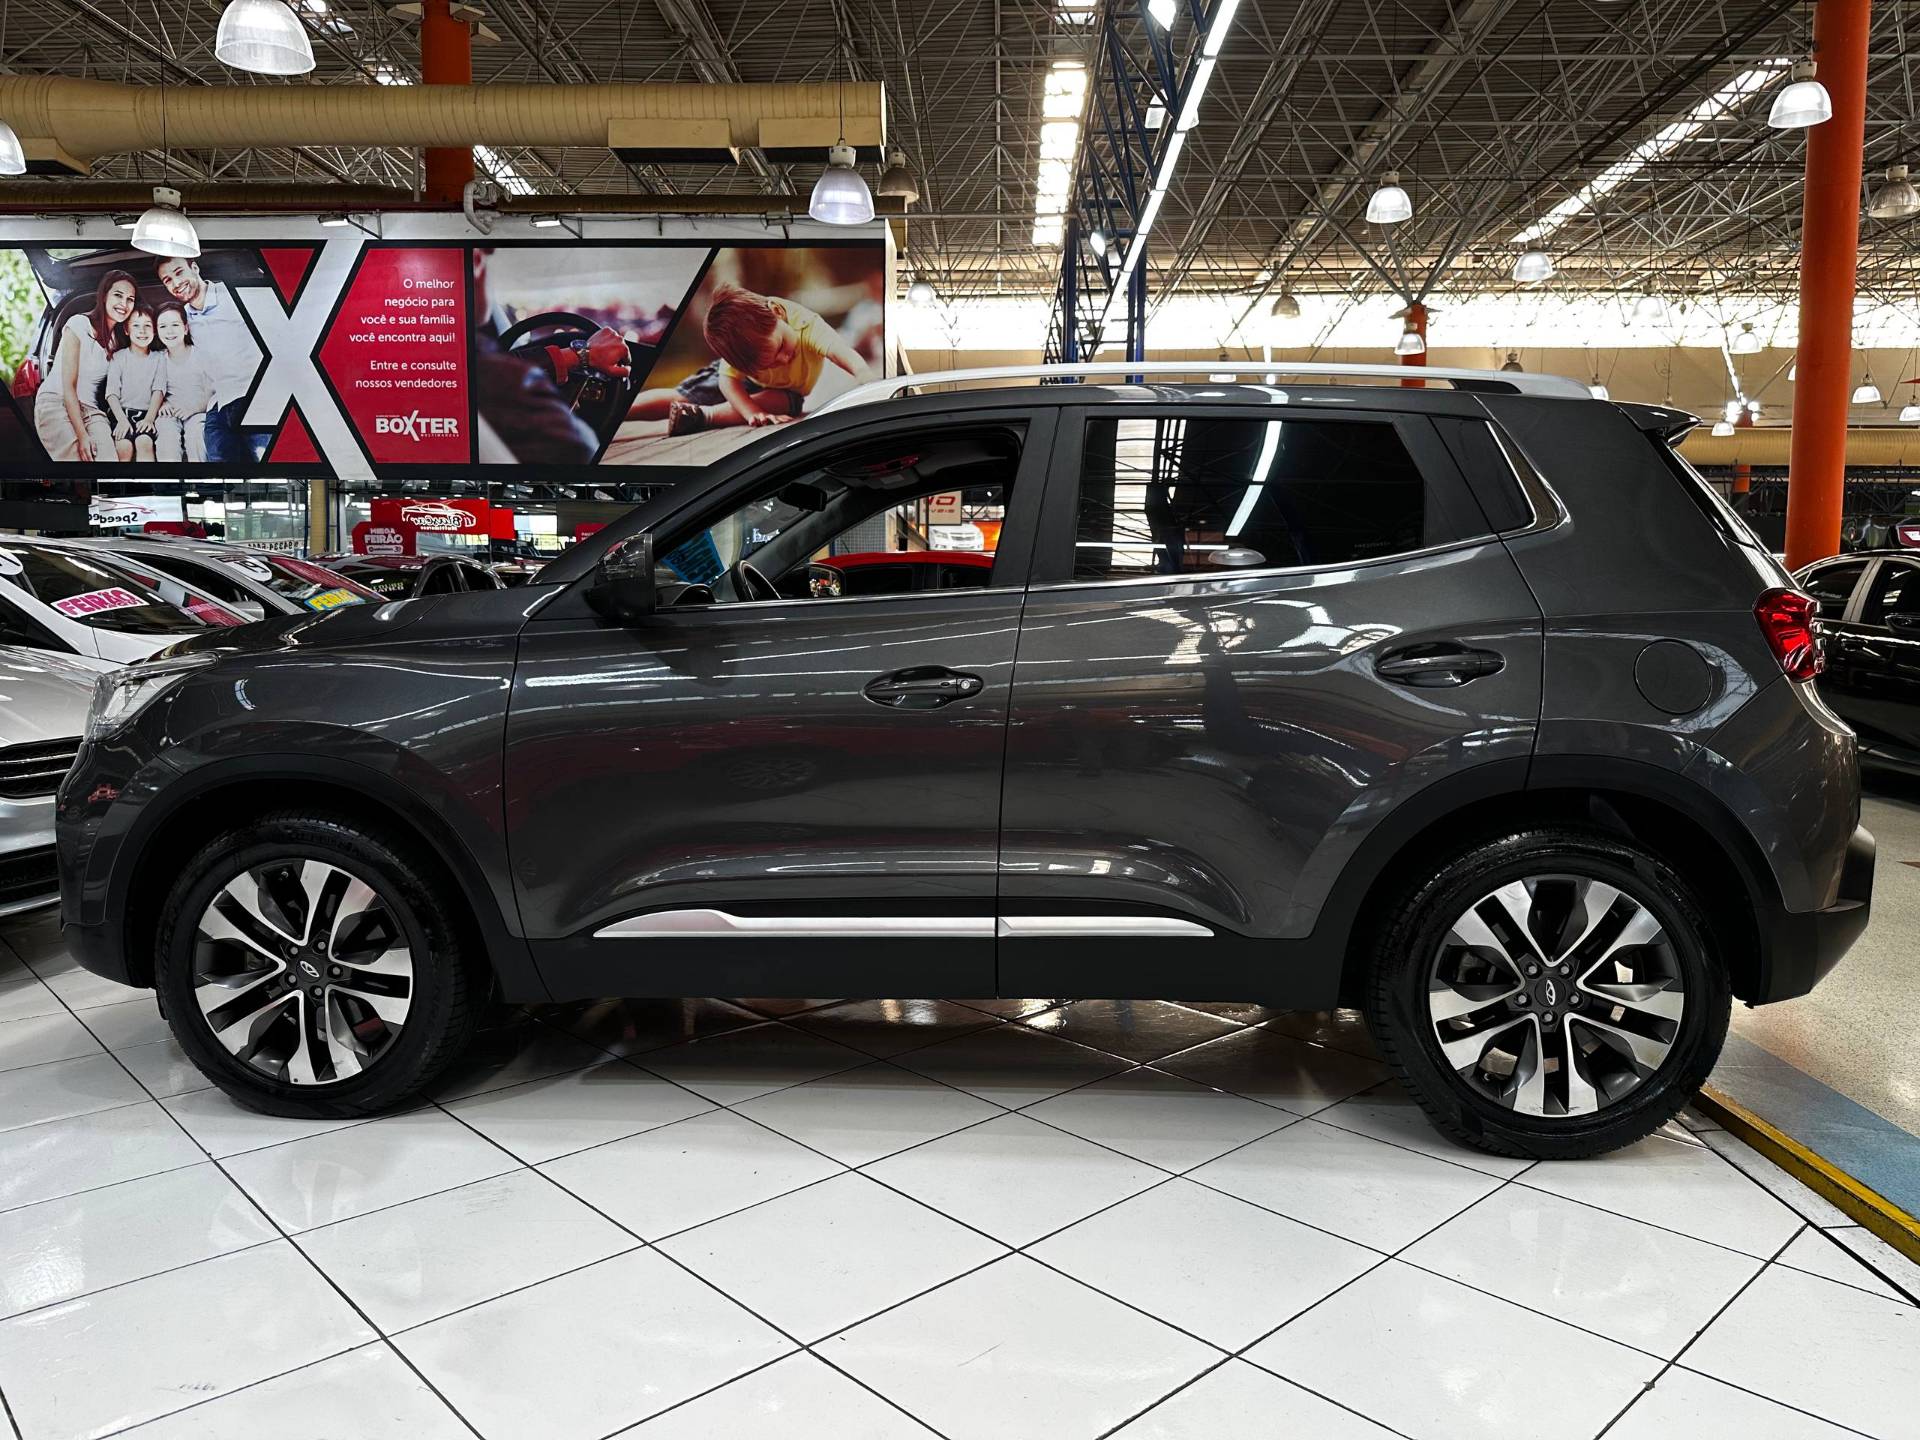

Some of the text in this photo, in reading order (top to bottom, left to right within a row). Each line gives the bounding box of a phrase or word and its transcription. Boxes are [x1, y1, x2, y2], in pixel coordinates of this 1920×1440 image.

[403, 278, 455, 289] O melhor
[384, 296, 455, 309] negócio para
[361, 314, 456, 325] você e sua família
[349, 332, 456, 345] você encontra aqui!
[370, 360, 457, 371] Entre e consulte
[355, 378, 458, 389] nossos vendedores
[375, 409, 459, 442] BOXTER
[364, 534, 404, 544] FEIRÃO
